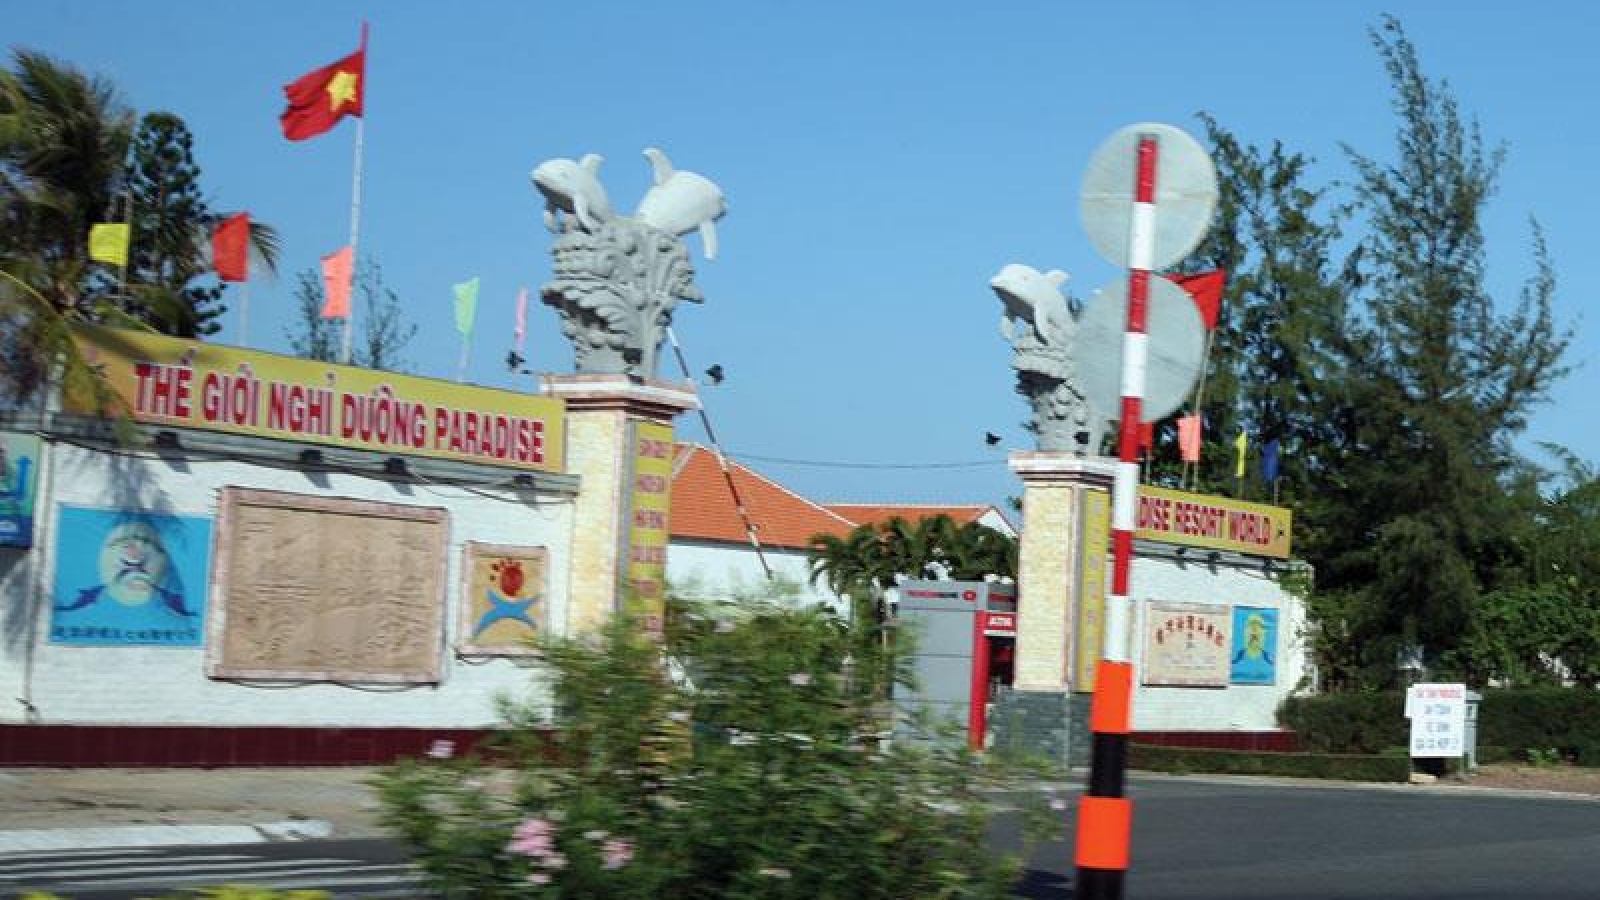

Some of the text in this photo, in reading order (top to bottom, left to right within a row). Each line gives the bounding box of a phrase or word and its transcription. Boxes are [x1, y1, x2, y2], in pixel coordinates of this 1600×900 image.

[433, 405, 545, 464] PARADISE
[1137, 495, 1272, 546] DISE RESORT WORLD
